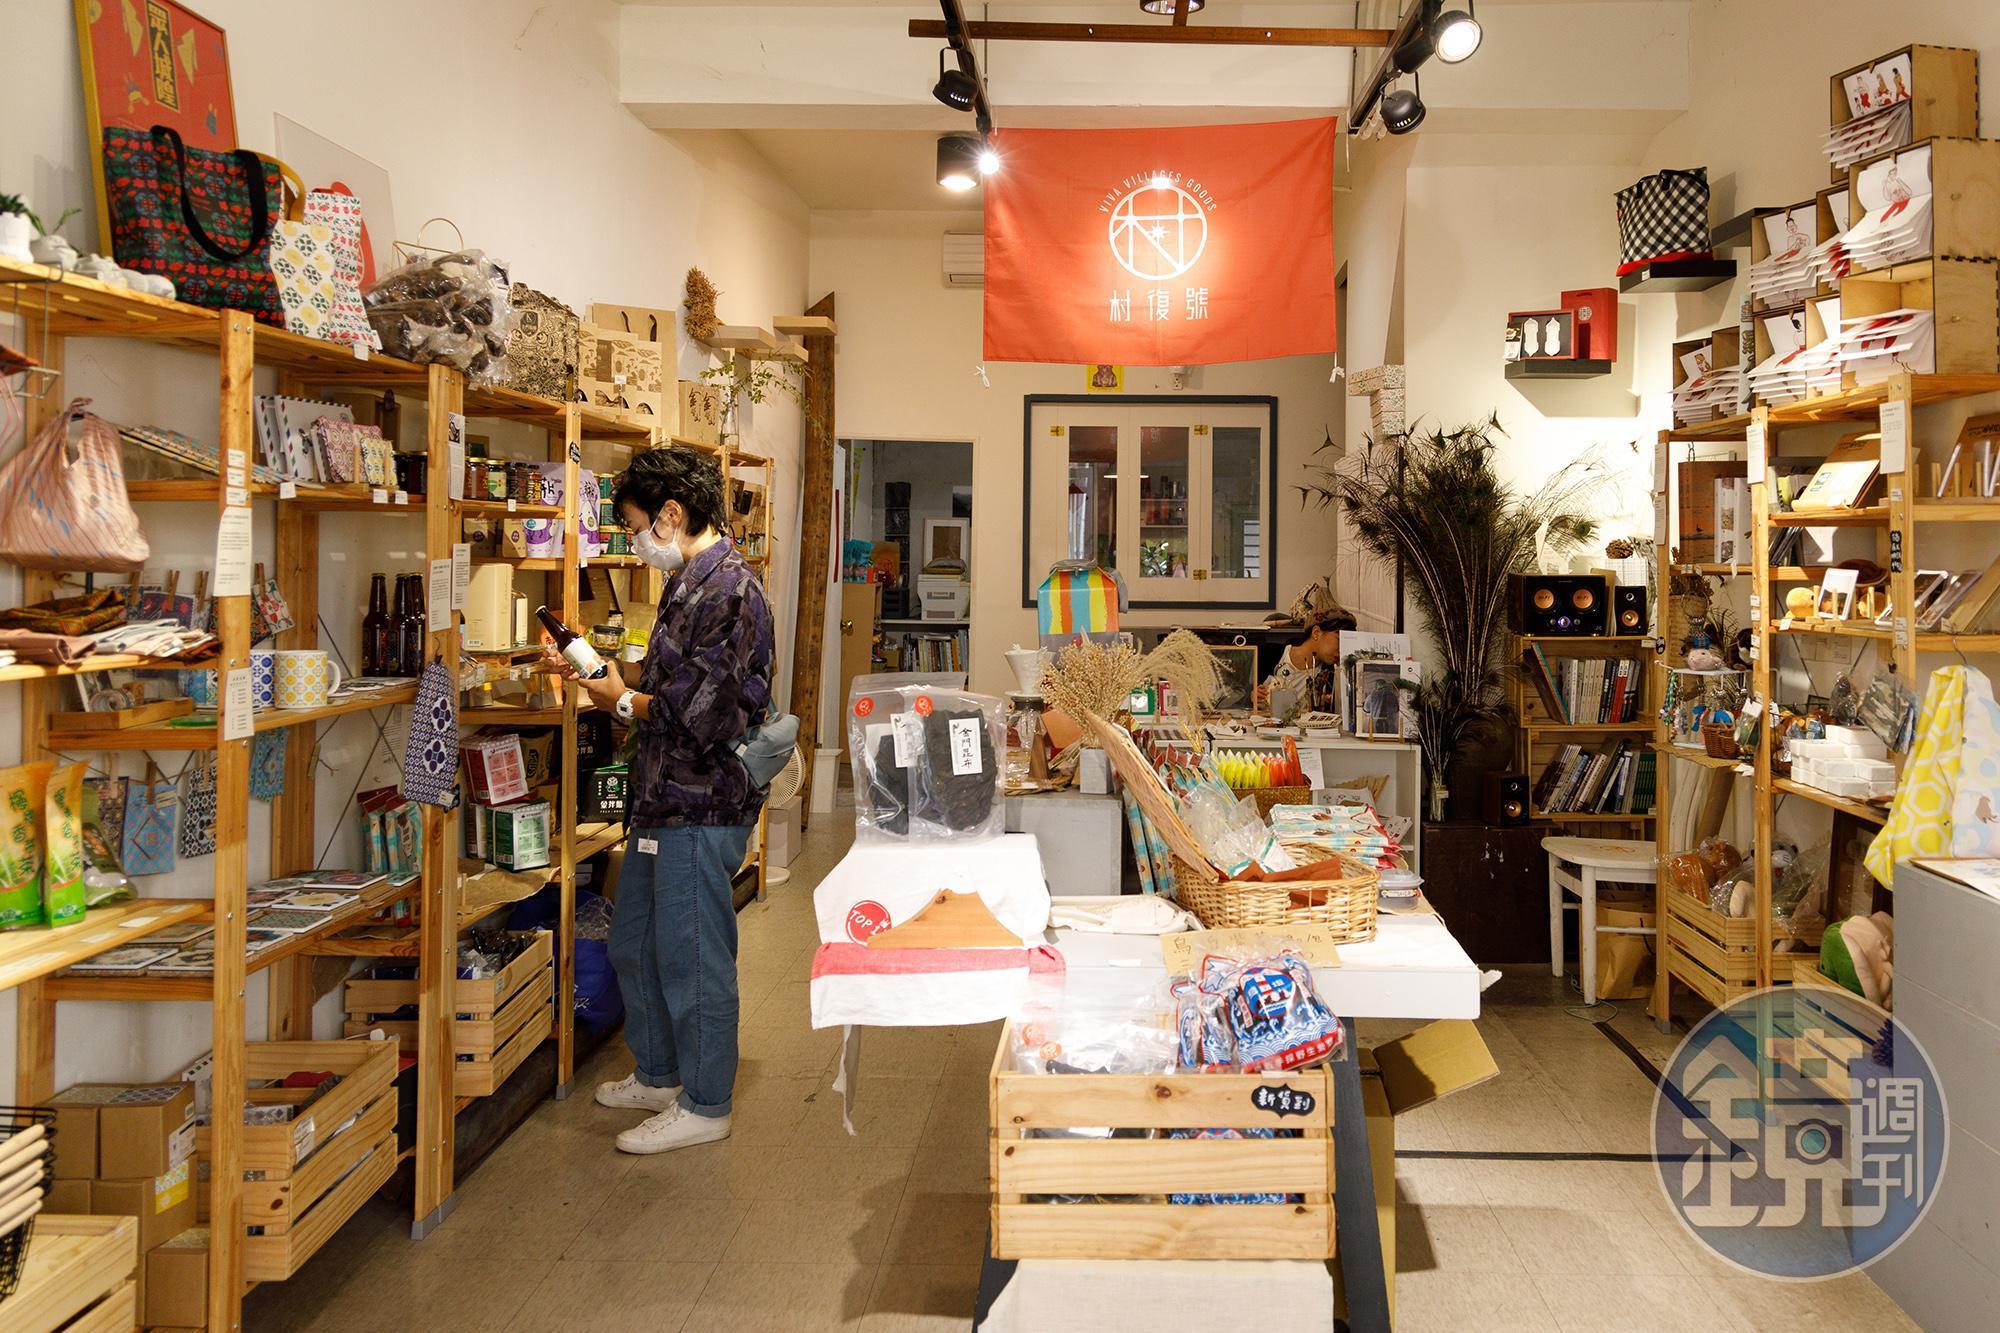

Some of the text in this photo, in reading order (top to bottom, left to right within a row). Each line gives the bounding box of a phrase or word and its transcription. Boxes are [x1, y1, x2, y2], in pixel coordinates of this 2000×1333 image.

[1099, 169, 1217, 213] VIVA VILLAGES GOODS
[1109, 287, 1209, 322] 村復號
[959, 727, 974, 769] 金門昆布
[849, 910, 873, 928] TOP
[1258, 1087, 1311, 1111] 新貨到
